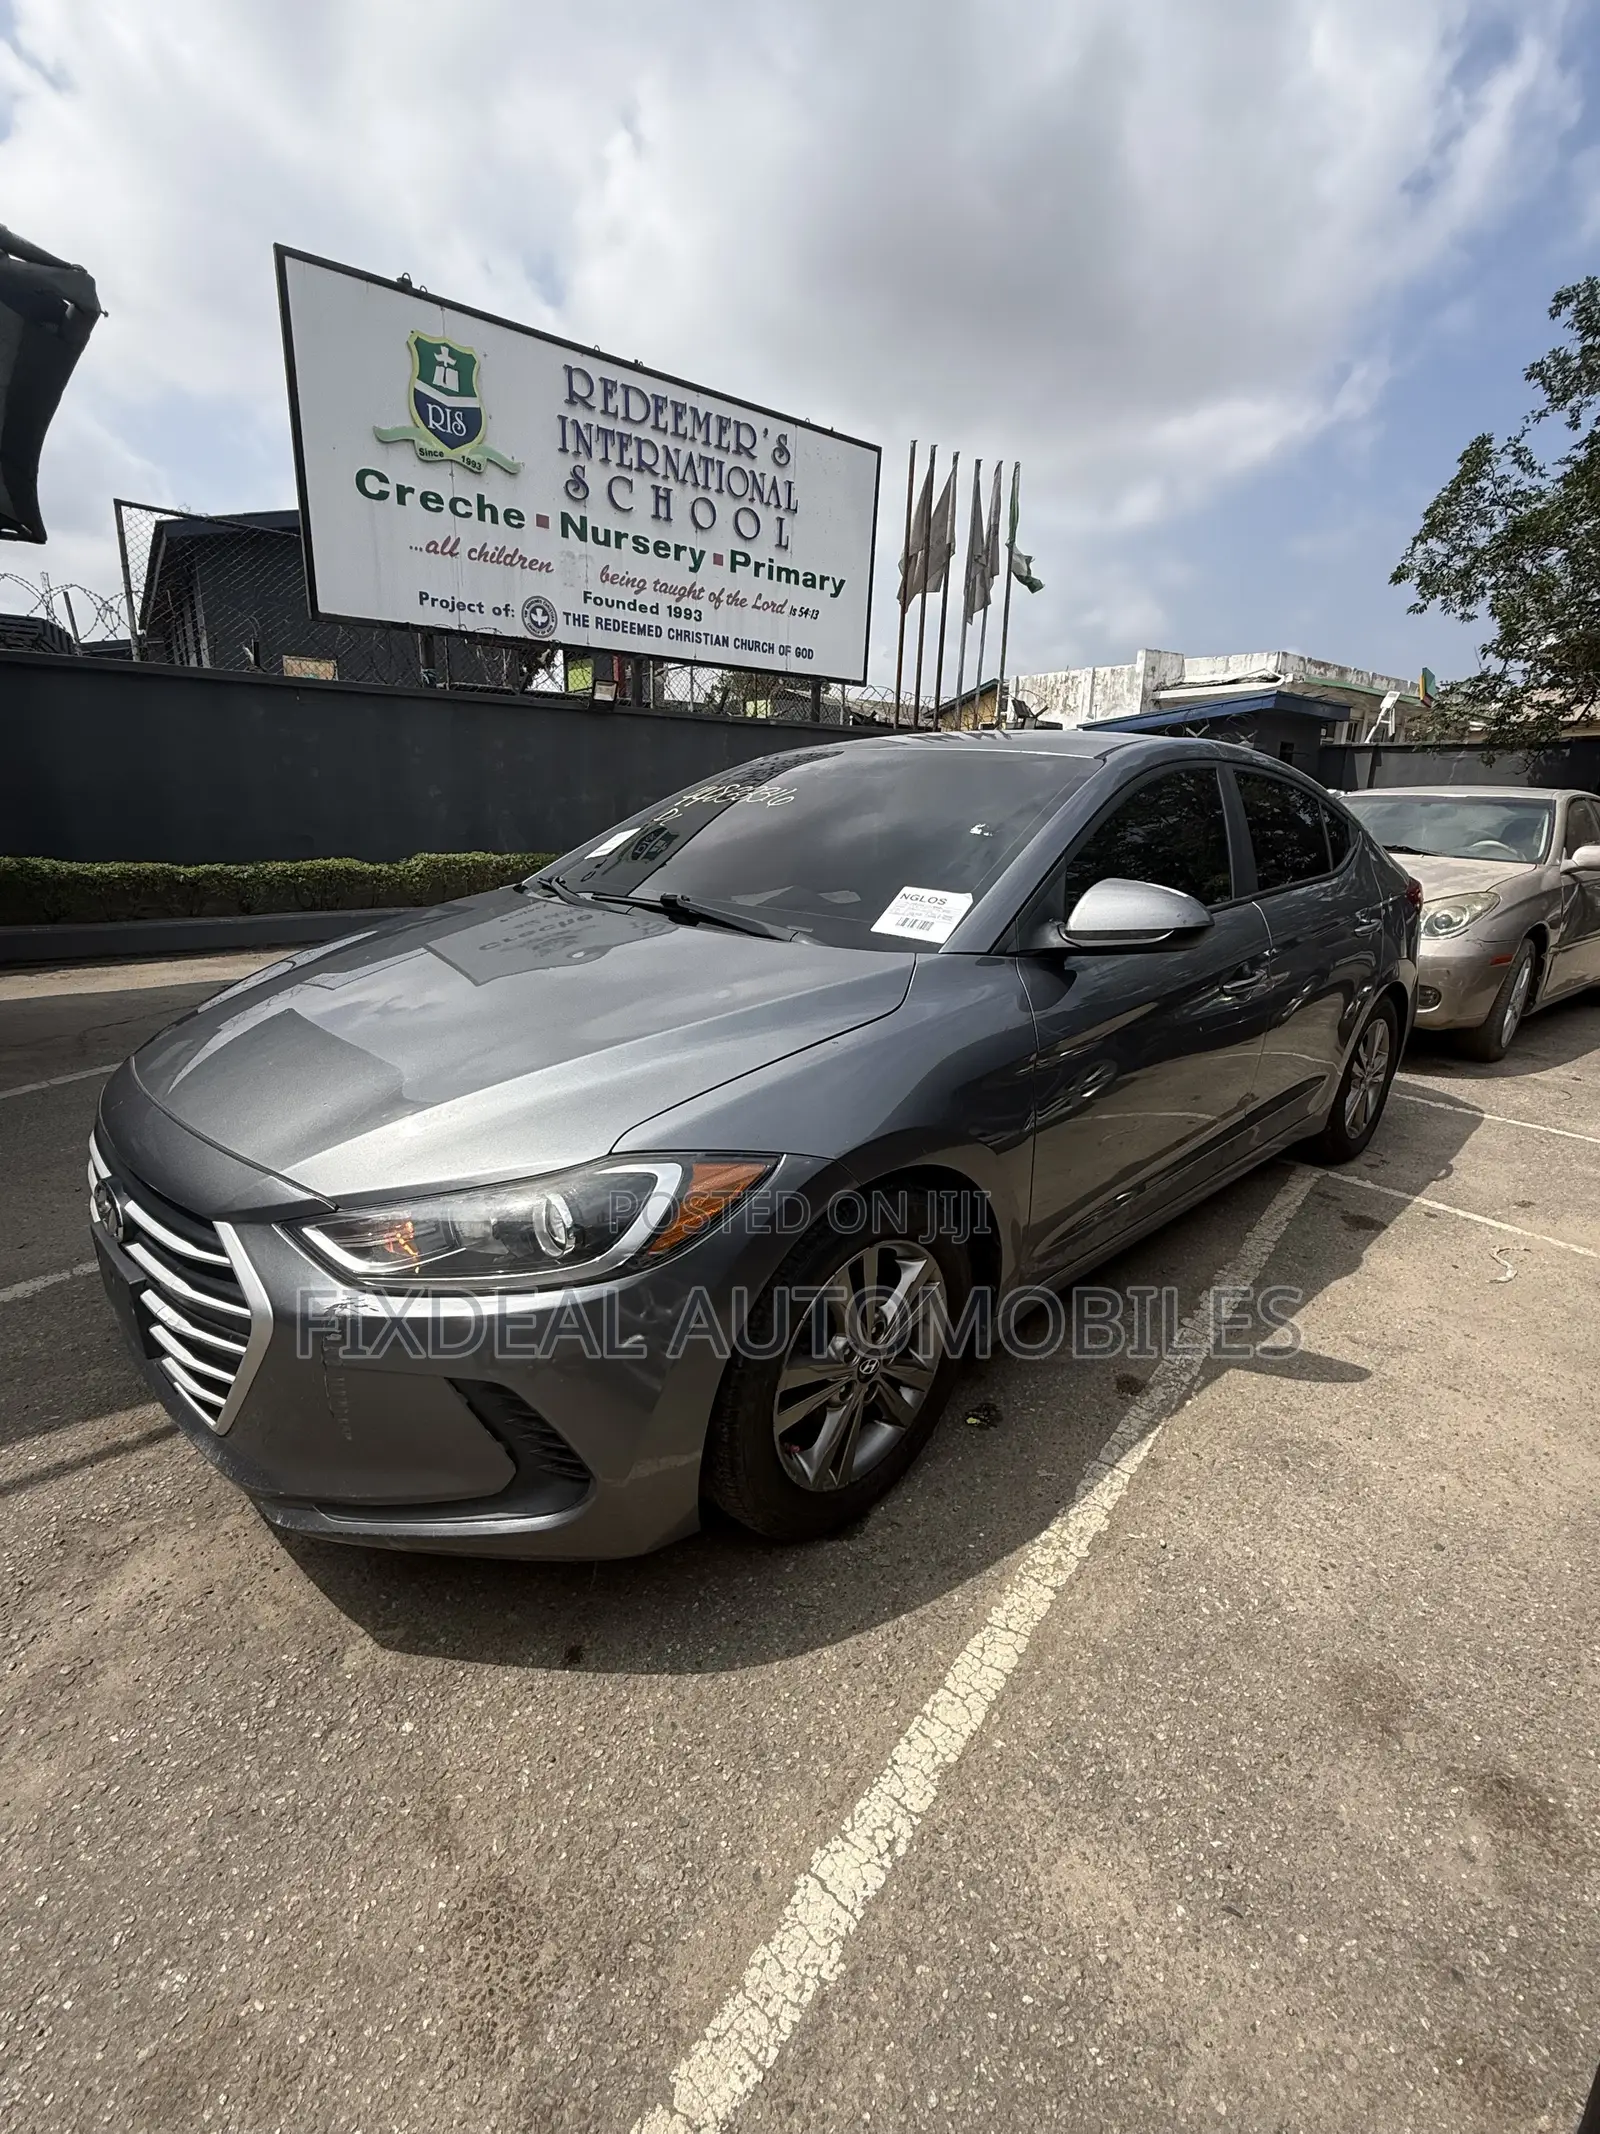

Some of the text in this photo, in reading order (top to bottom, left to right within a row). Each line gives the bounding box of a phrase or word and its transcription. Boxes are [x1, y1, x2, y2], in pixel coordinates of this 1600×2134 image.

[426, 403, 467, 437] RIS
[563, 364, 791, 467] REDEEMER'S
[418, 447, 482, 471] Since 1993
[557, 414, 799, 515] INTERNATIONAL
[355, 468, 847, 599] Creche Nursery Primary
[564, 464, 790, 551] SCHOOL
[467, 542, 555, 574] children
[599, 564, 648, 595] being
[653, 579, 705, 601] taught
[708, 588, 727, 610] of
[726, 589, 749, 609] the
[751, 592, 789, 615] Lord
[798, 606, 820, 621] 54:13
[582, 590, 703, 622] Founded 1993
[418, 590, 485, 615] Project
[492, 603, 516, 618] of:
[562, 611, 590, 629] THE
[595, 616, 663, 639] REDEEMED
[667, 627, 730, 649] CHRISTIAN
[733, 637, 775, 656] CHURCH
[778, 644, 792, 657] OF
[794, 646, 814, 661] GOD
[900, 892, 948, 906] NGLOS
